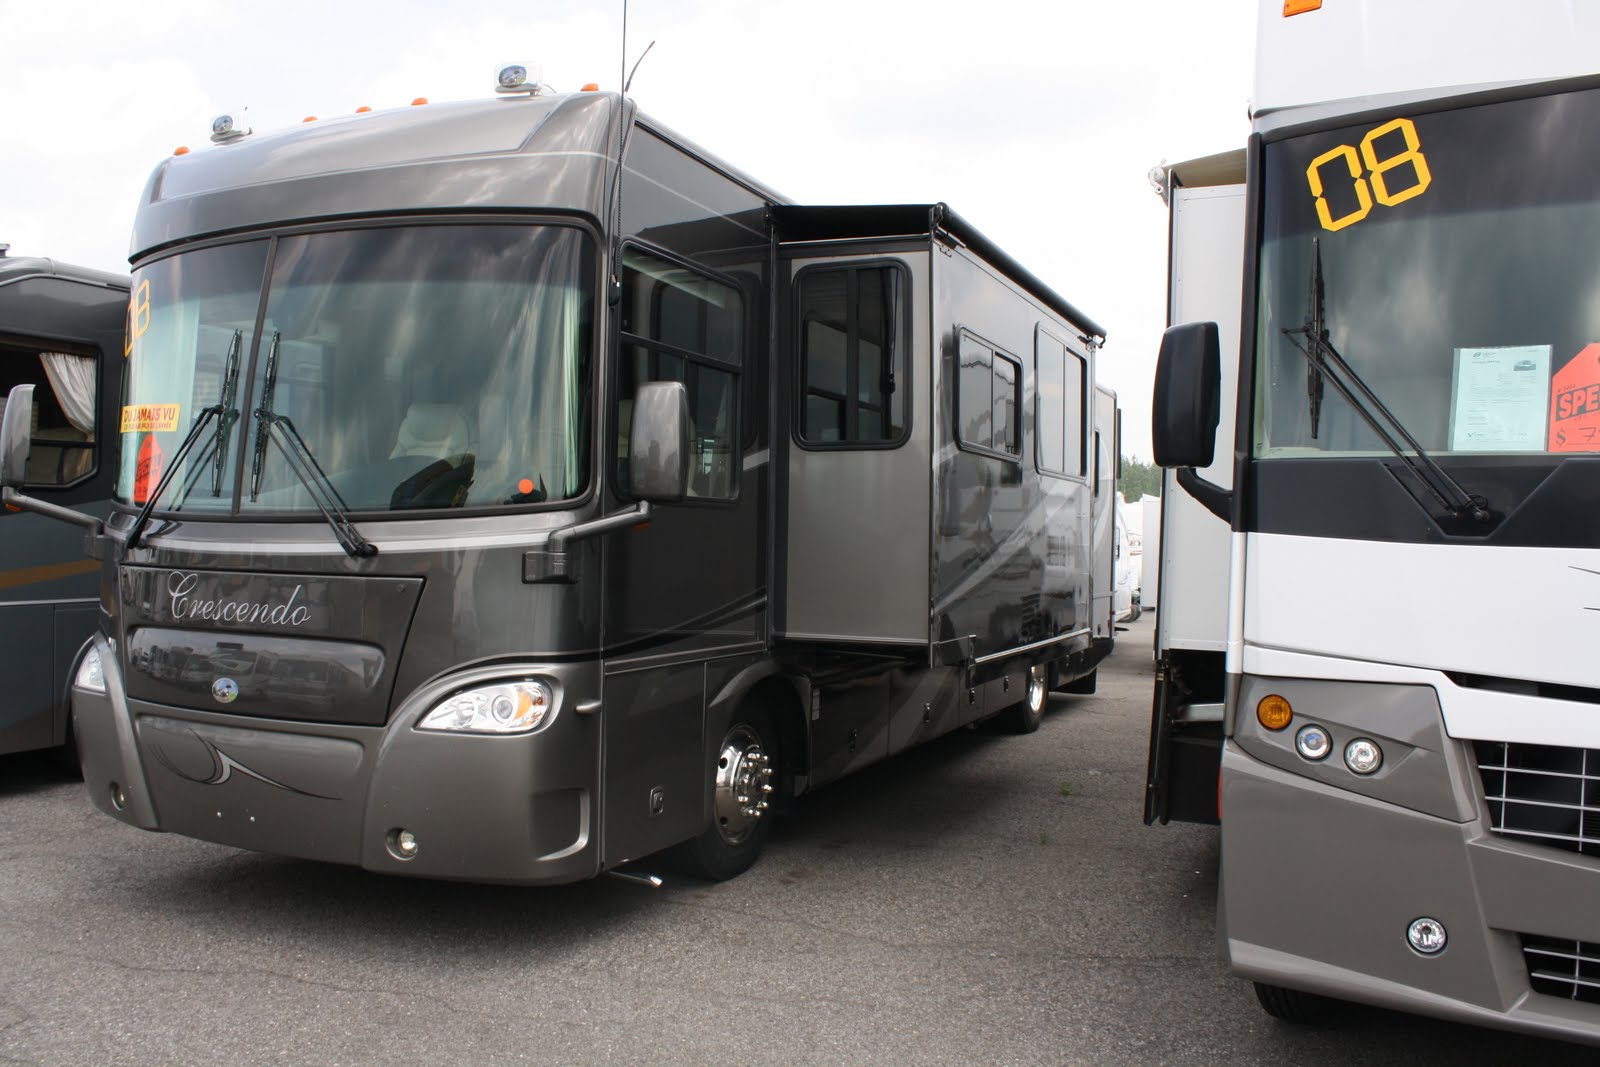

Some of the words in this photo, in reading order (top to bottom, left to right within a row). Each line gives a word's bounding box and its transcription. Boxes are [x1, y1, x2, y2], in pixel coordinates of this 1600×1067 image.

[1306, 117, 1432, 232] 08
[133, 408, 161, 422] JAMAIS
[163, 407, 176, 421] VU
[1555, 428, 1566, 448] $
[167, 570, 312, 626] Crescendo
